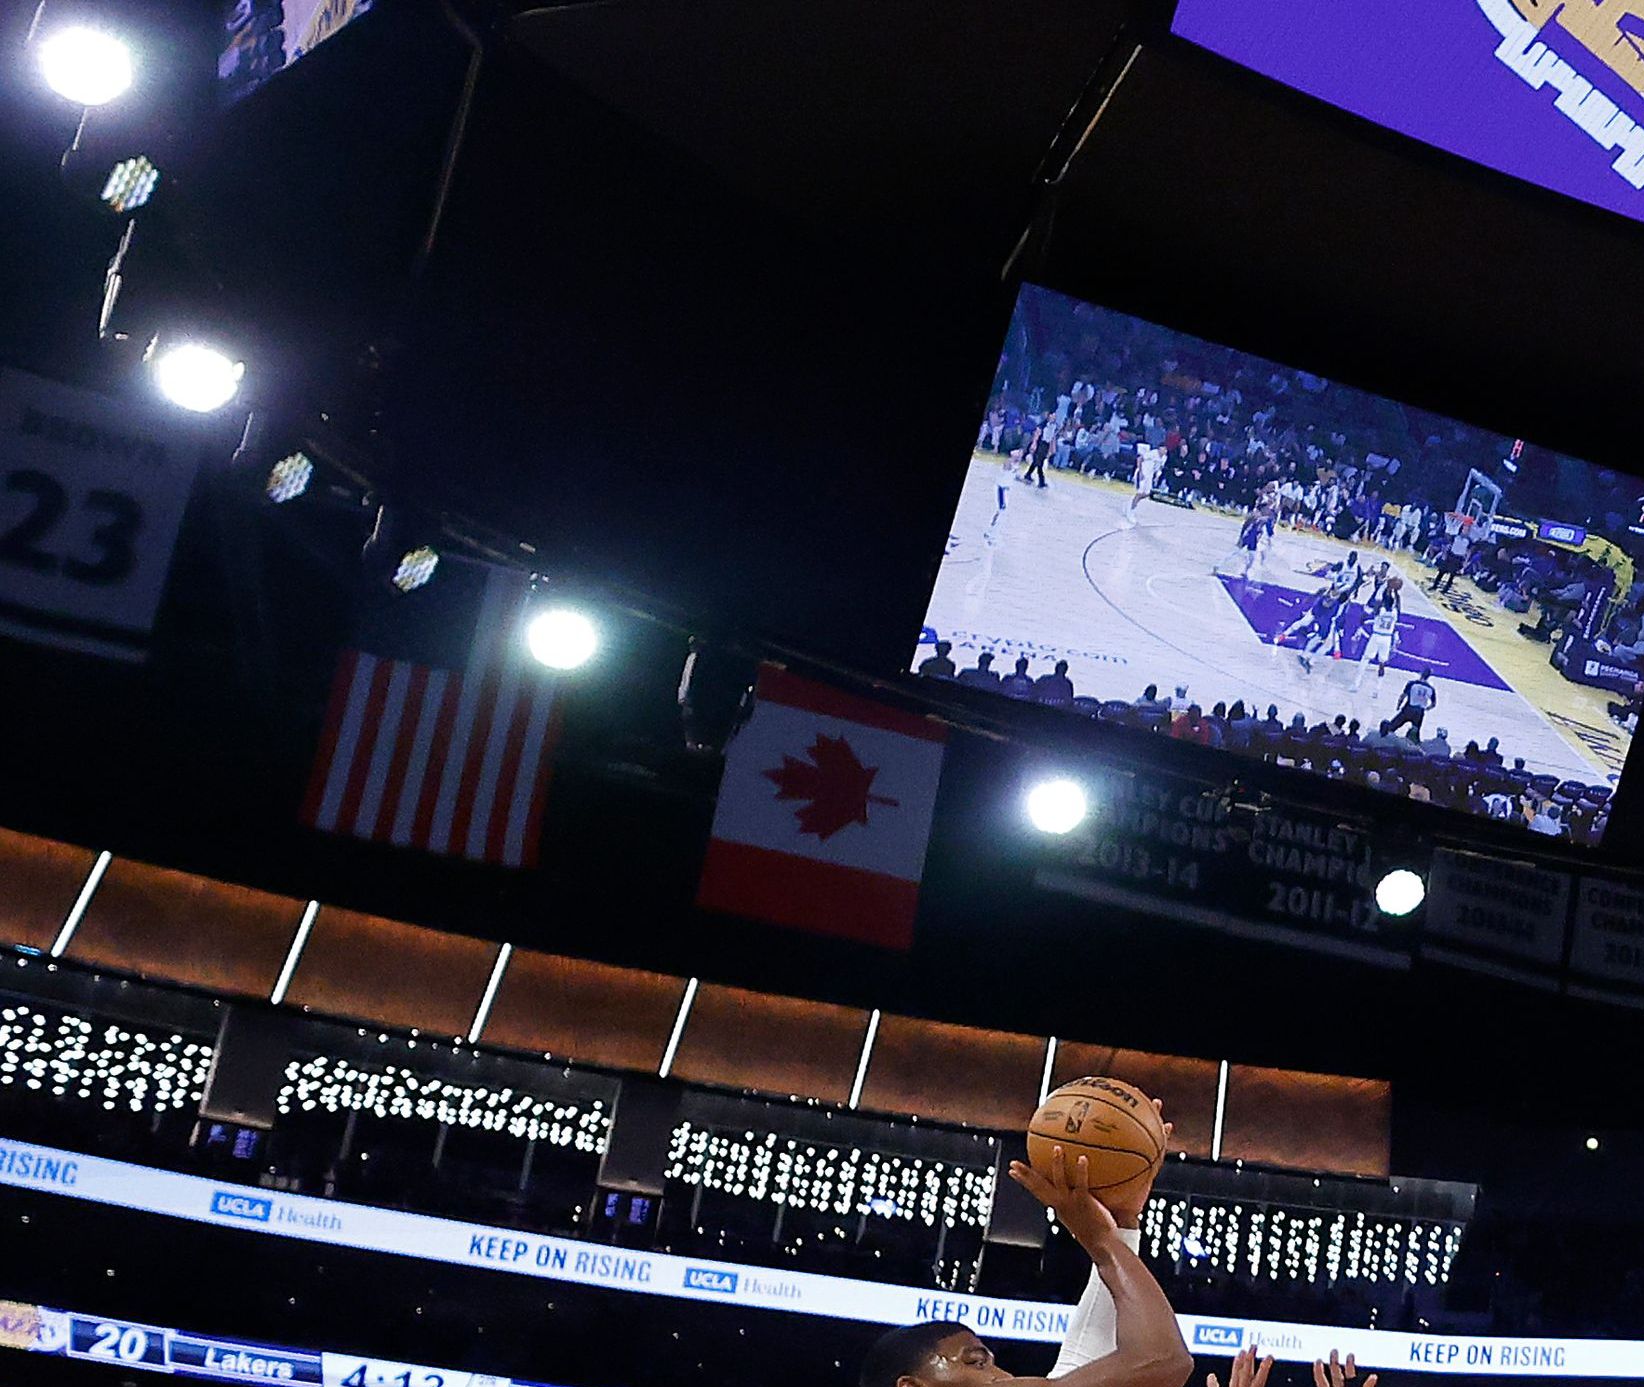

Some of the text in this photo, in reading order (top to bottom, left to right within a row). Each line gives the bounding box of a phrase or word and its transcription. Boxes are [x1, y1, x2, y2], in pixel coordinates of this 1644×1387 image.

[0, 470, 143, 585] 23
[217, 1197, 343, 1231] UCLA Health
[469, 1233, 652, 1284] KEEP ON RISING
[689, 1273, 803, 1299] UCLA Health
[916, 1297, 1069, 1335] KEEP ON RISIN
[89, 1322, 149, 1363] 20
[1198, 1326, 1303, 1351] UCLA Health
[1409, 1341, 1566, 1368] KEEP ON RISING
[204, 1347, 296, 1381] Lakers
